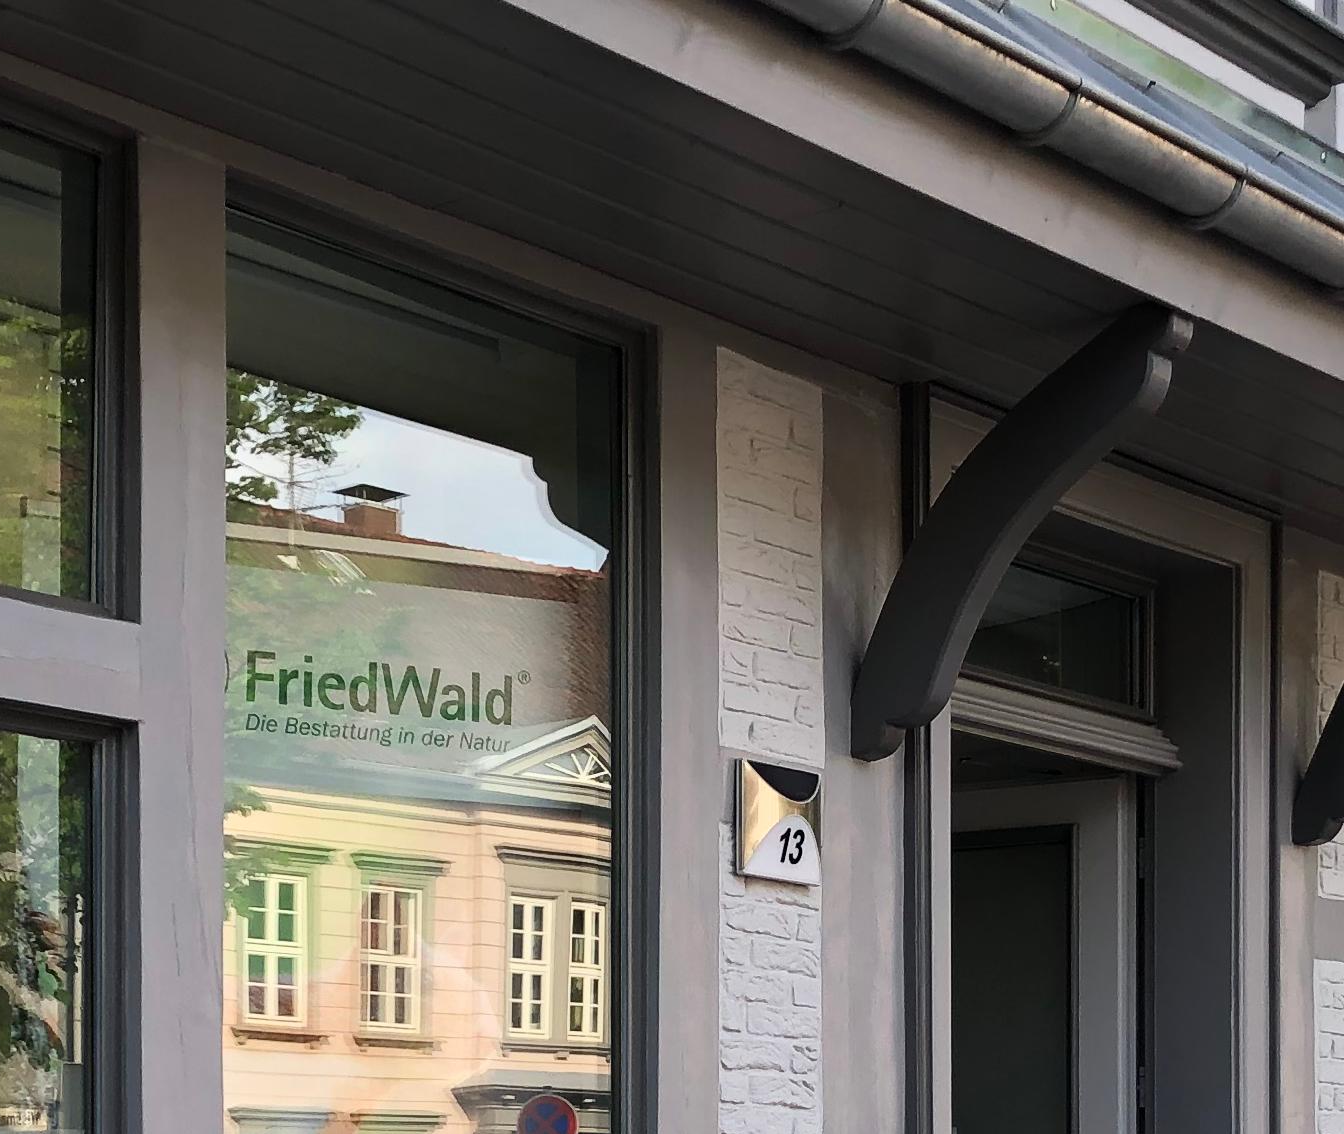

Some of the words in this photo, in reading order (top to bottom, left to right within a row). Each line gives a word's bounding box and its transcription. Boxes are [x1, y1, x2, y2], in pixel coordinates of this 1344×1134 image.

[245, 713, 278, 733] Die
[285, 717, 393, 747] Bestattung
[398, 726, 415, 744] in
[422, 729, 452, 748] der
[779, 827, 805, 865] 13
